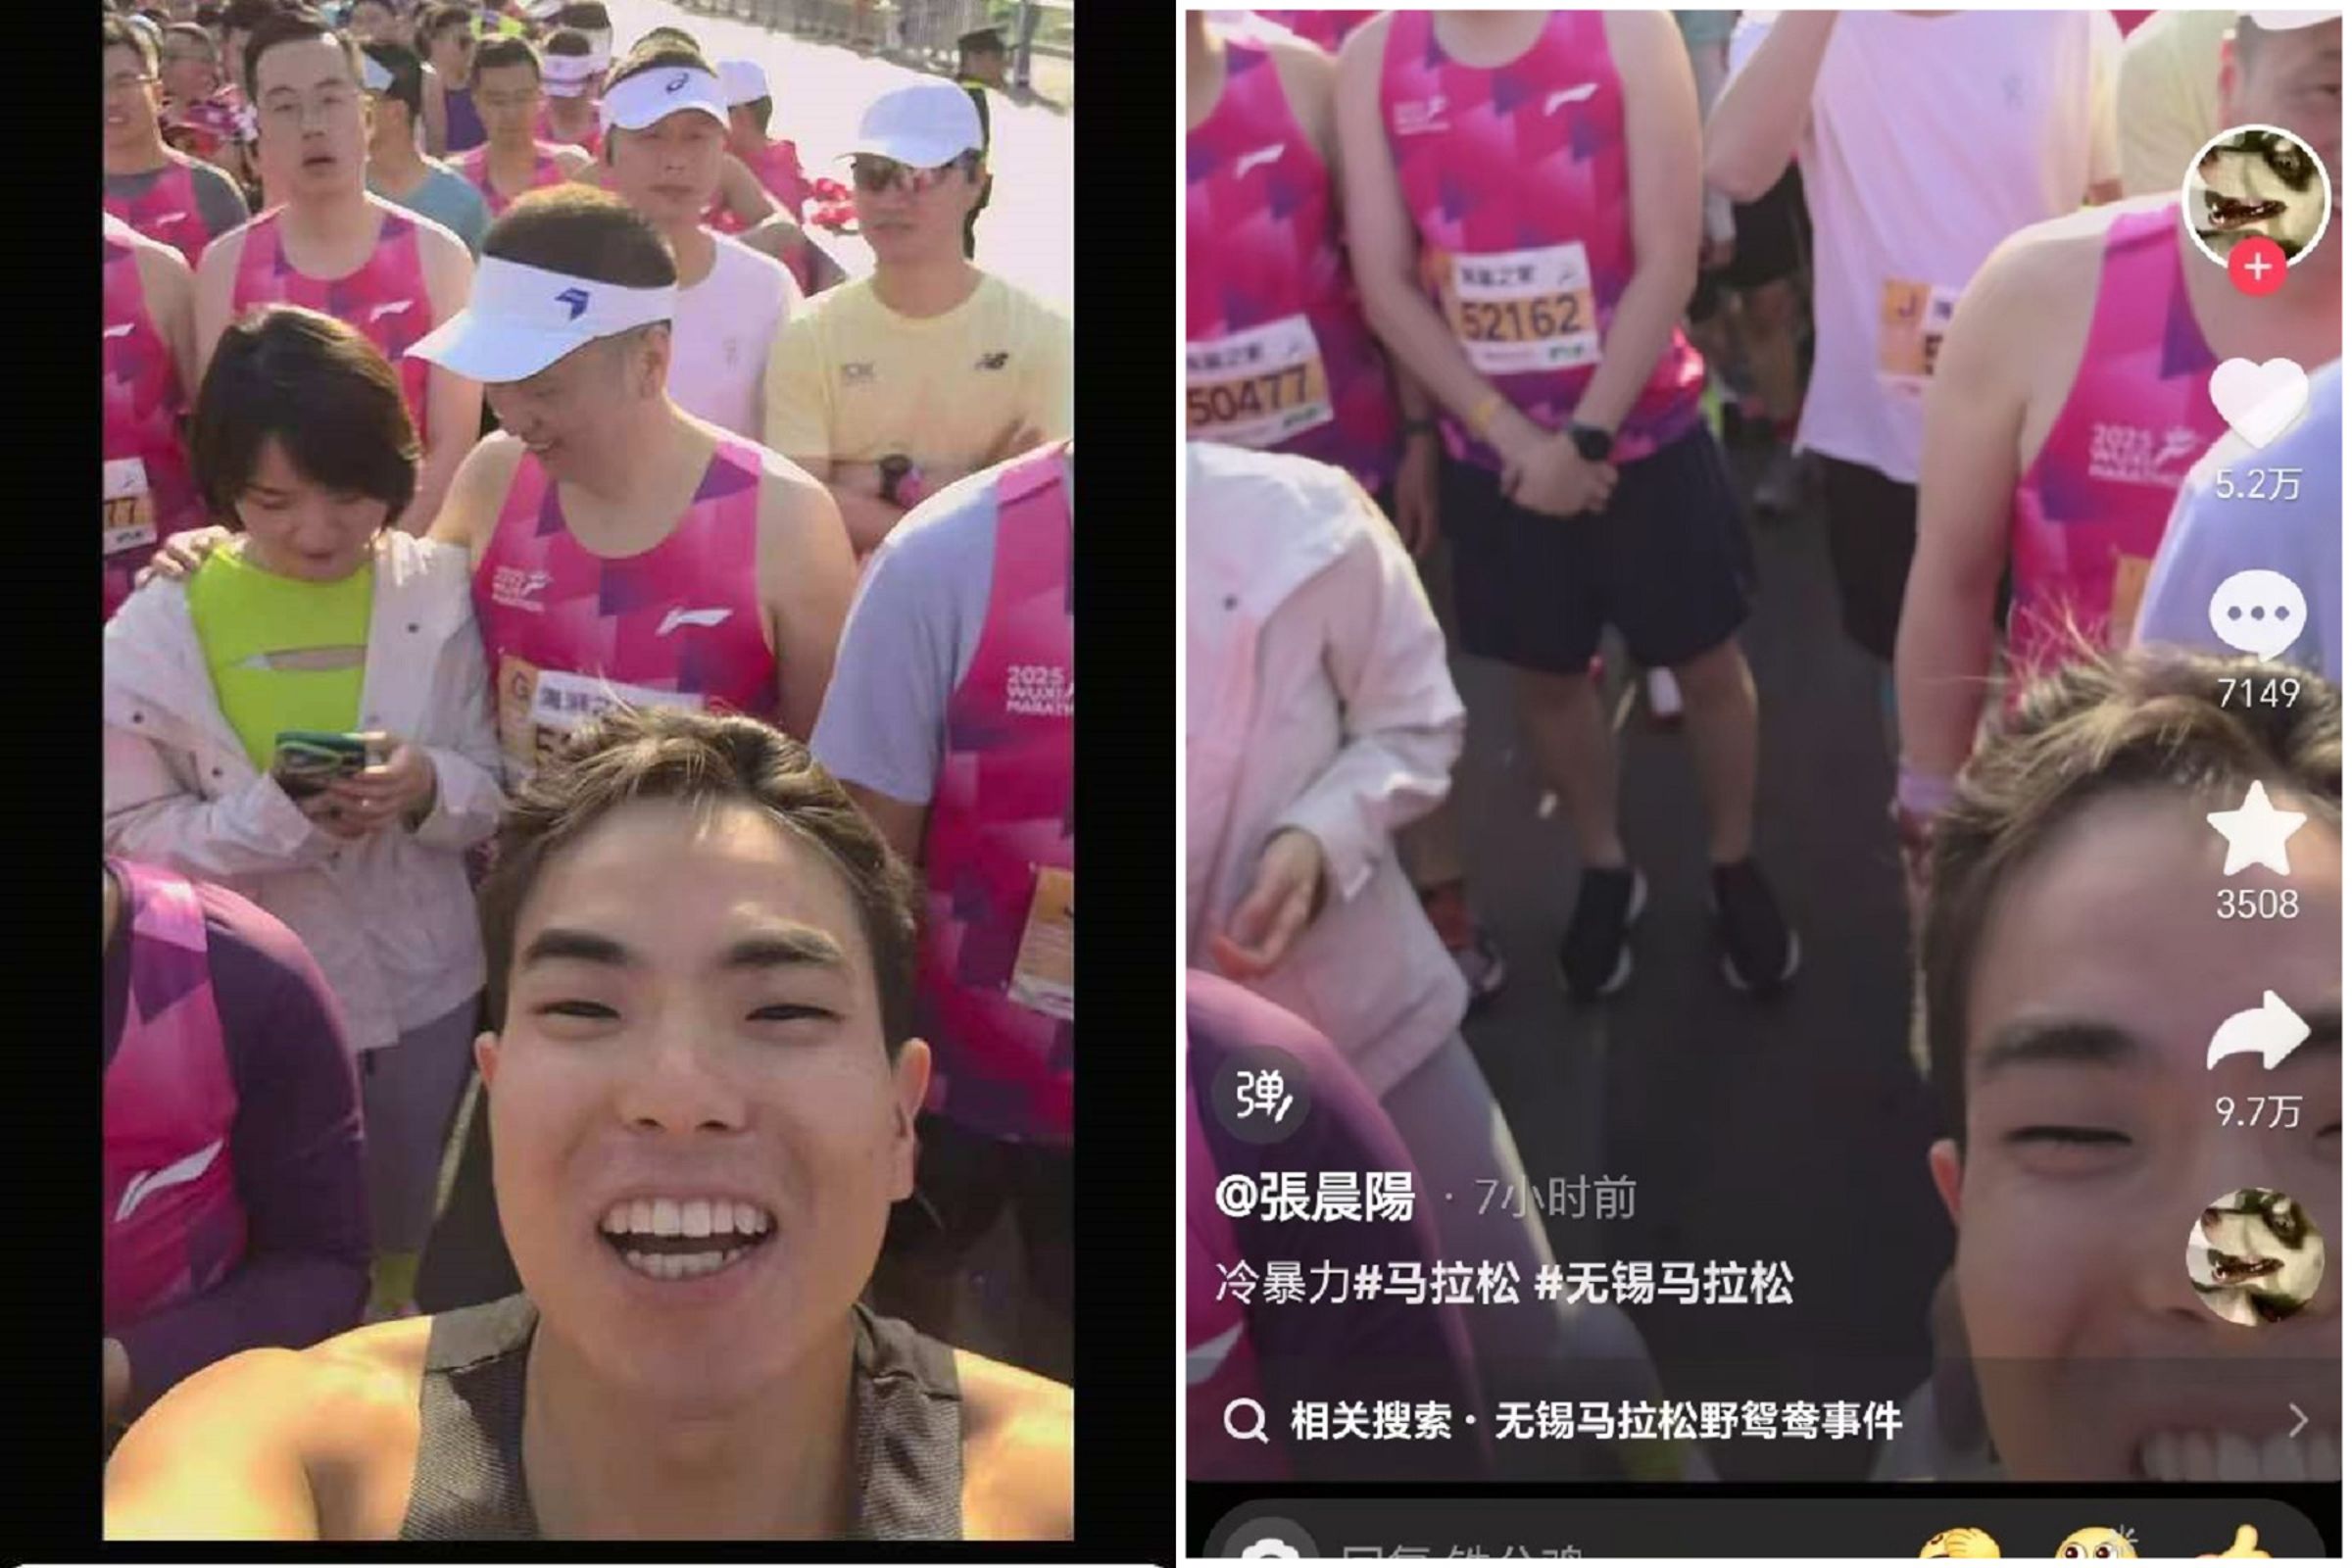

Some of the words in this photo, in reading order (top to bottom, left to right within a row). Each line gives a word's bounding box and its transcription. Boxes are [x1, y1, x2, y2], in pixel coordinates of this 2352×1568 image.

[1461, 293, 1584, 341] 52162
[1187, 364, 1307, 426] 50477
[1006, 665, 1064, 685] 2025
